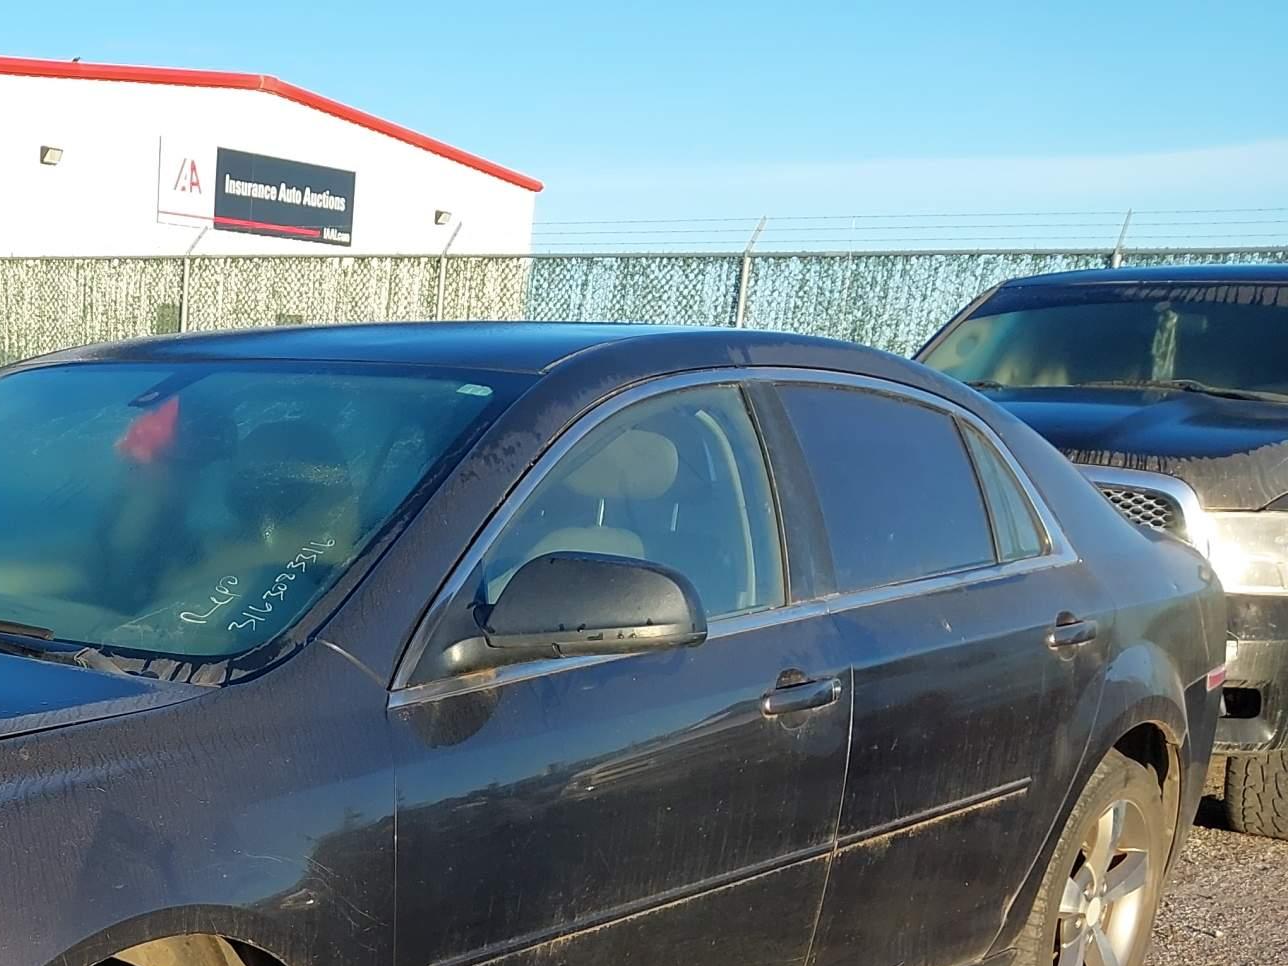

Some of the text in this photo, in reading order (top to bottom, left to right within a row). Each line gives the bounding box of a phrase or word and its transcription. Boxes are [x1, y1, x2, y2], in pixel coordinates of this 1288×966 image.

[224, 174, 346, 212] Insurance Auto Auctions
